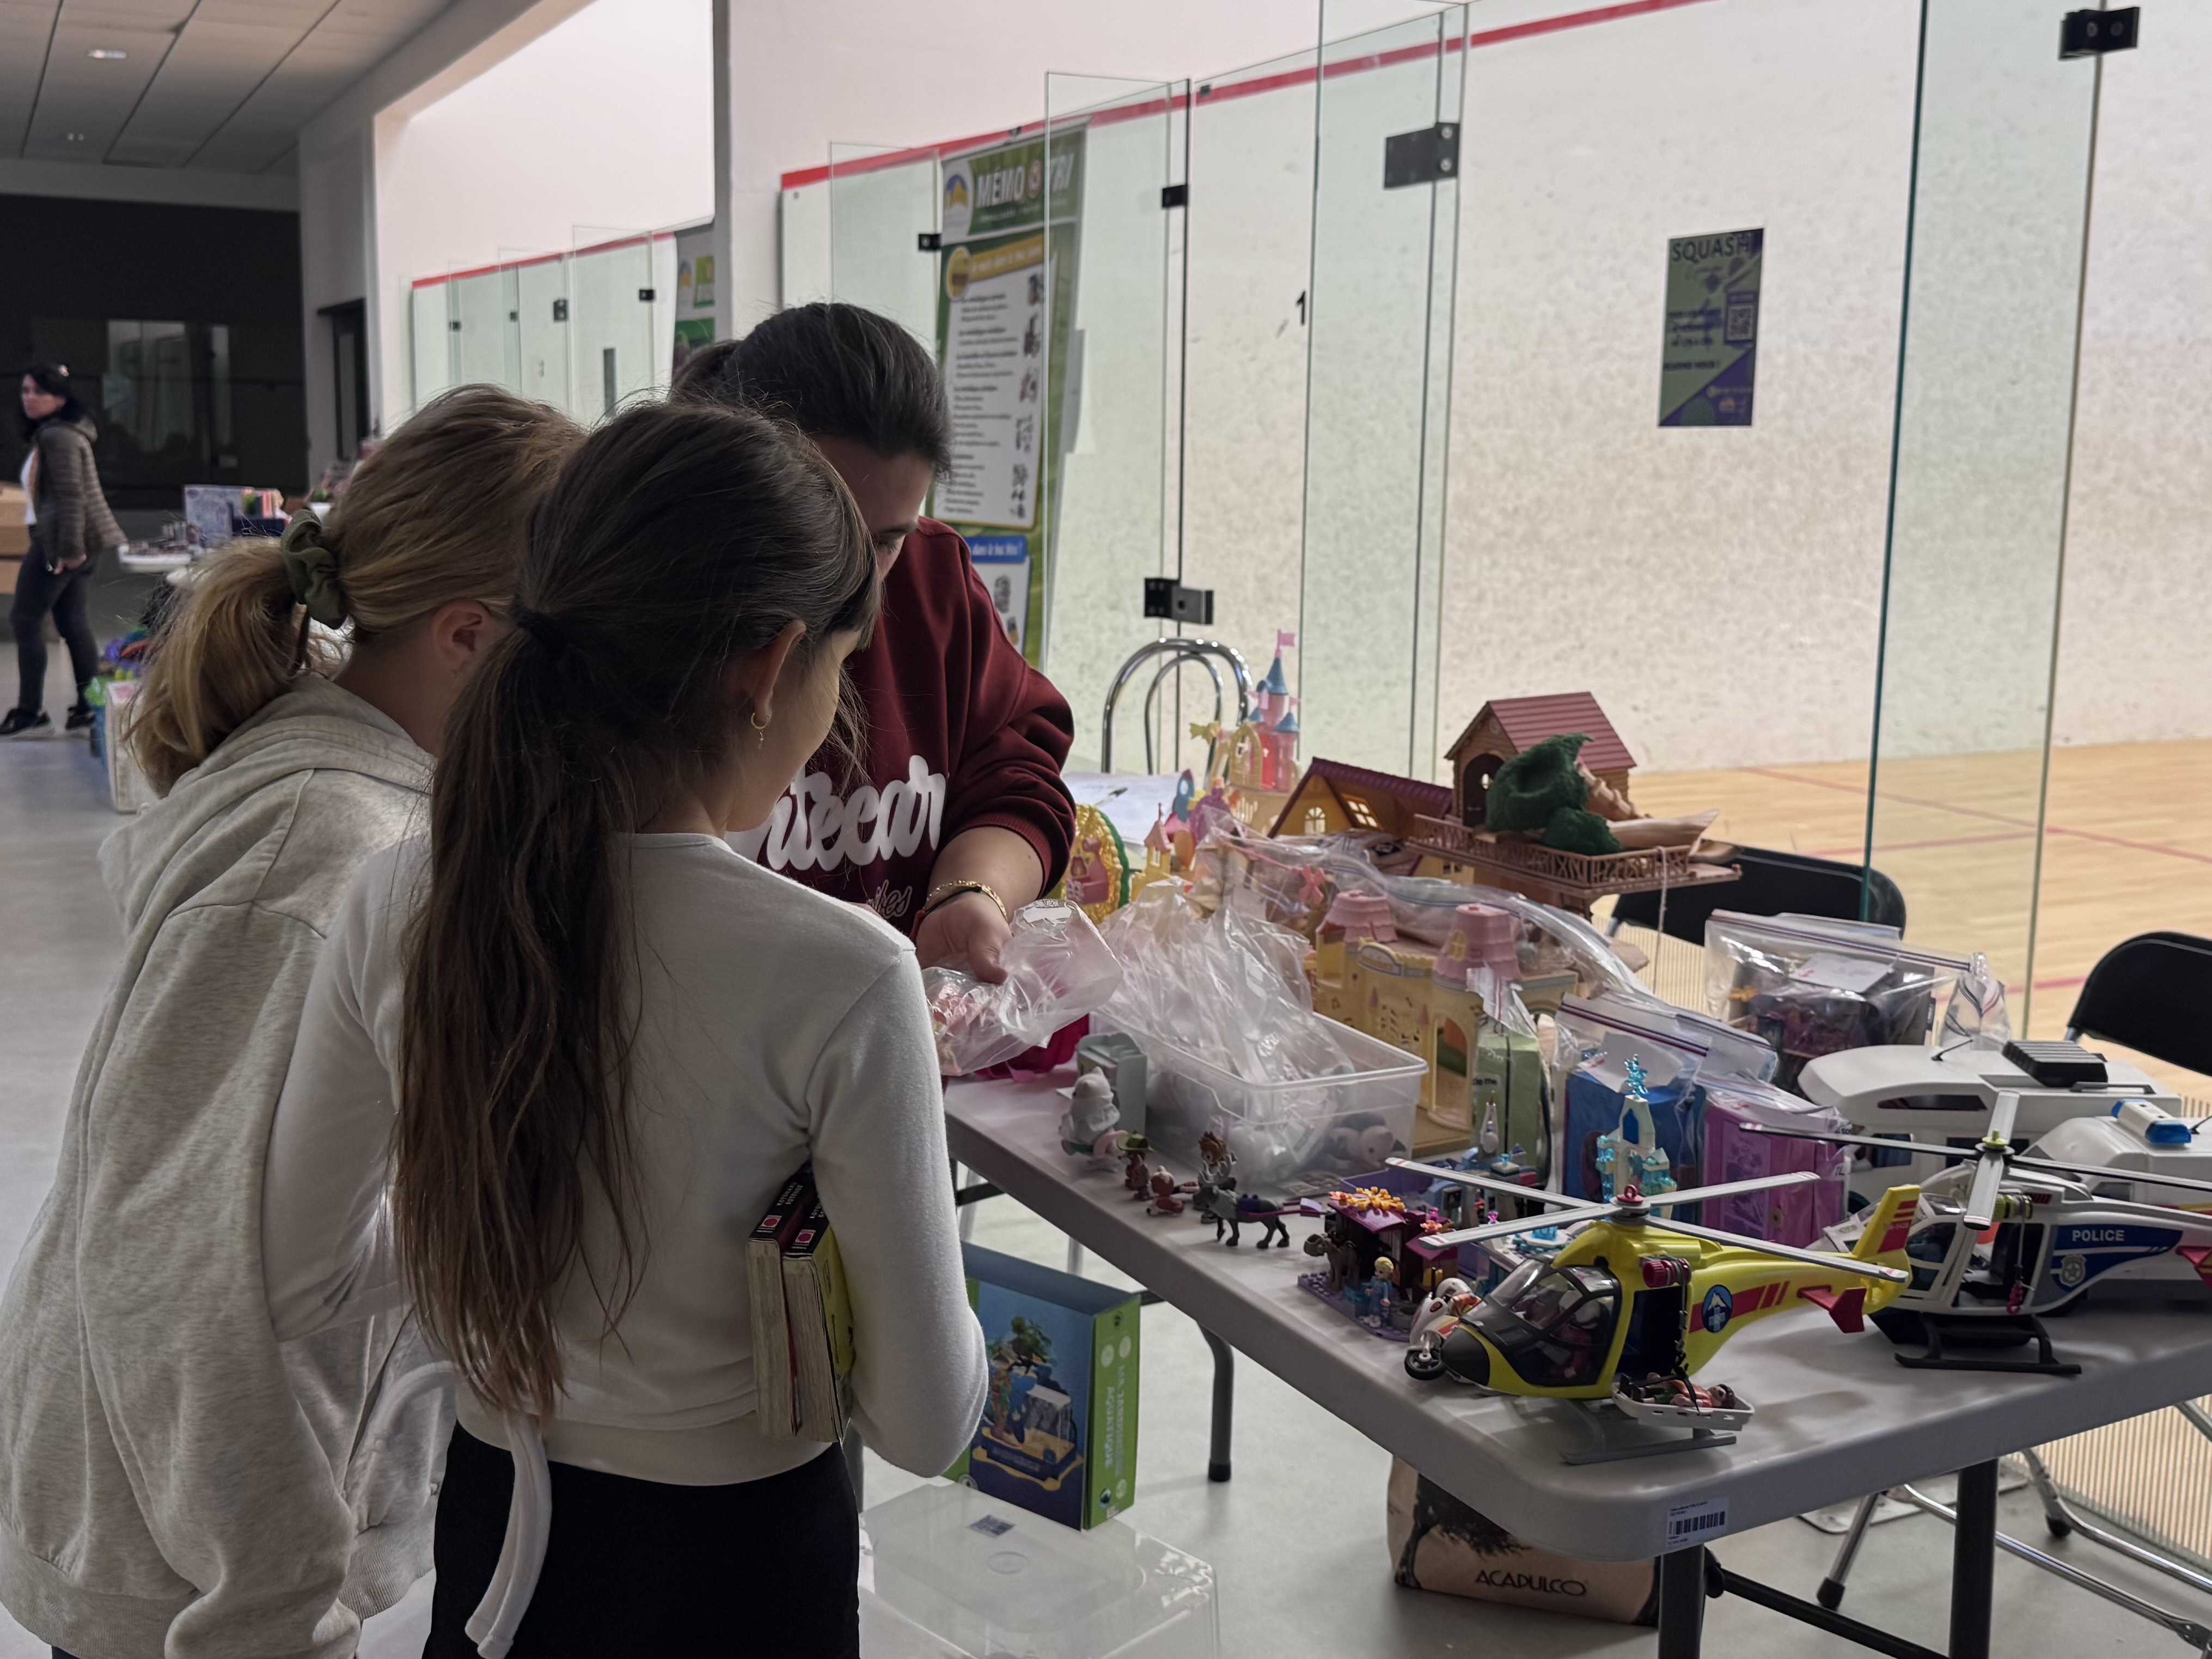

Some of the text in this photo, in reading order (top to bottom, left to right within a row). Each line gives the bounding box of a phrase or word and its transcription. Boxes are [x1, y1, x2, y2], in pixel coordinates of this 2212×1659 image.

[976, 153, 1076, 209] MÉMO TRI
[1672, 234, 1750, 264] SQUASH
[1296, 290, 1306, 326] 1
[2072, 1229, 2125, 1242] POLICE
[1475, 1569, 1587, 1596] ACAPULCO
